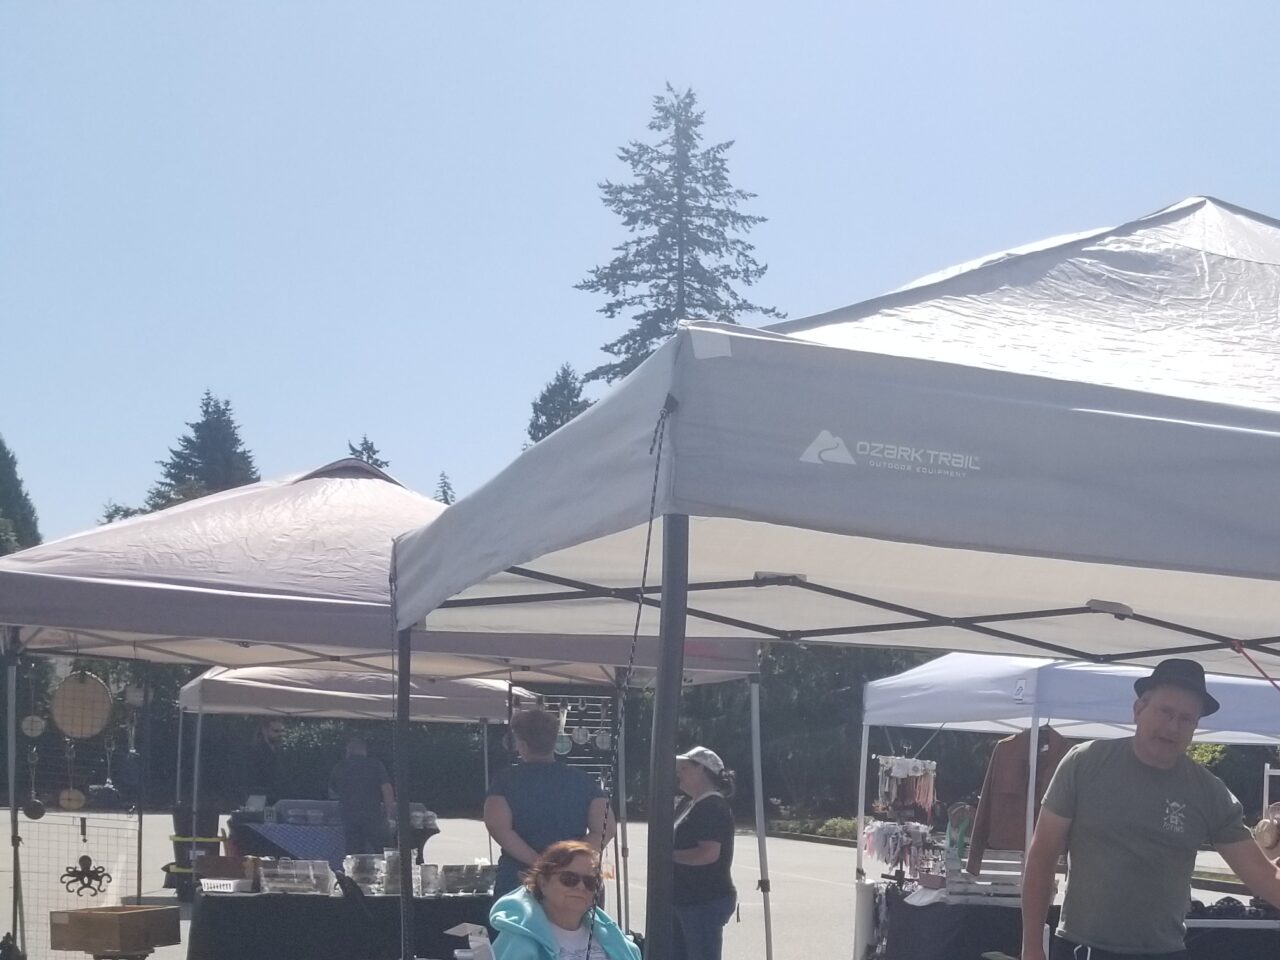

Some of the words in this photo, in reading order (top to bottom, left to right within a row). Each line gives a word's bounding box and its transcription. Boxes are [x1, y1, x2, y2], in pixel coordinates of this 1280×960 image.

[856, 441, 924, 463] OZARK
[926, 449, 981, 470] TRAIL
[869, 460, 912, 472] OUTDOOR
[916, 467, 967, 478] EQUIPMENT
